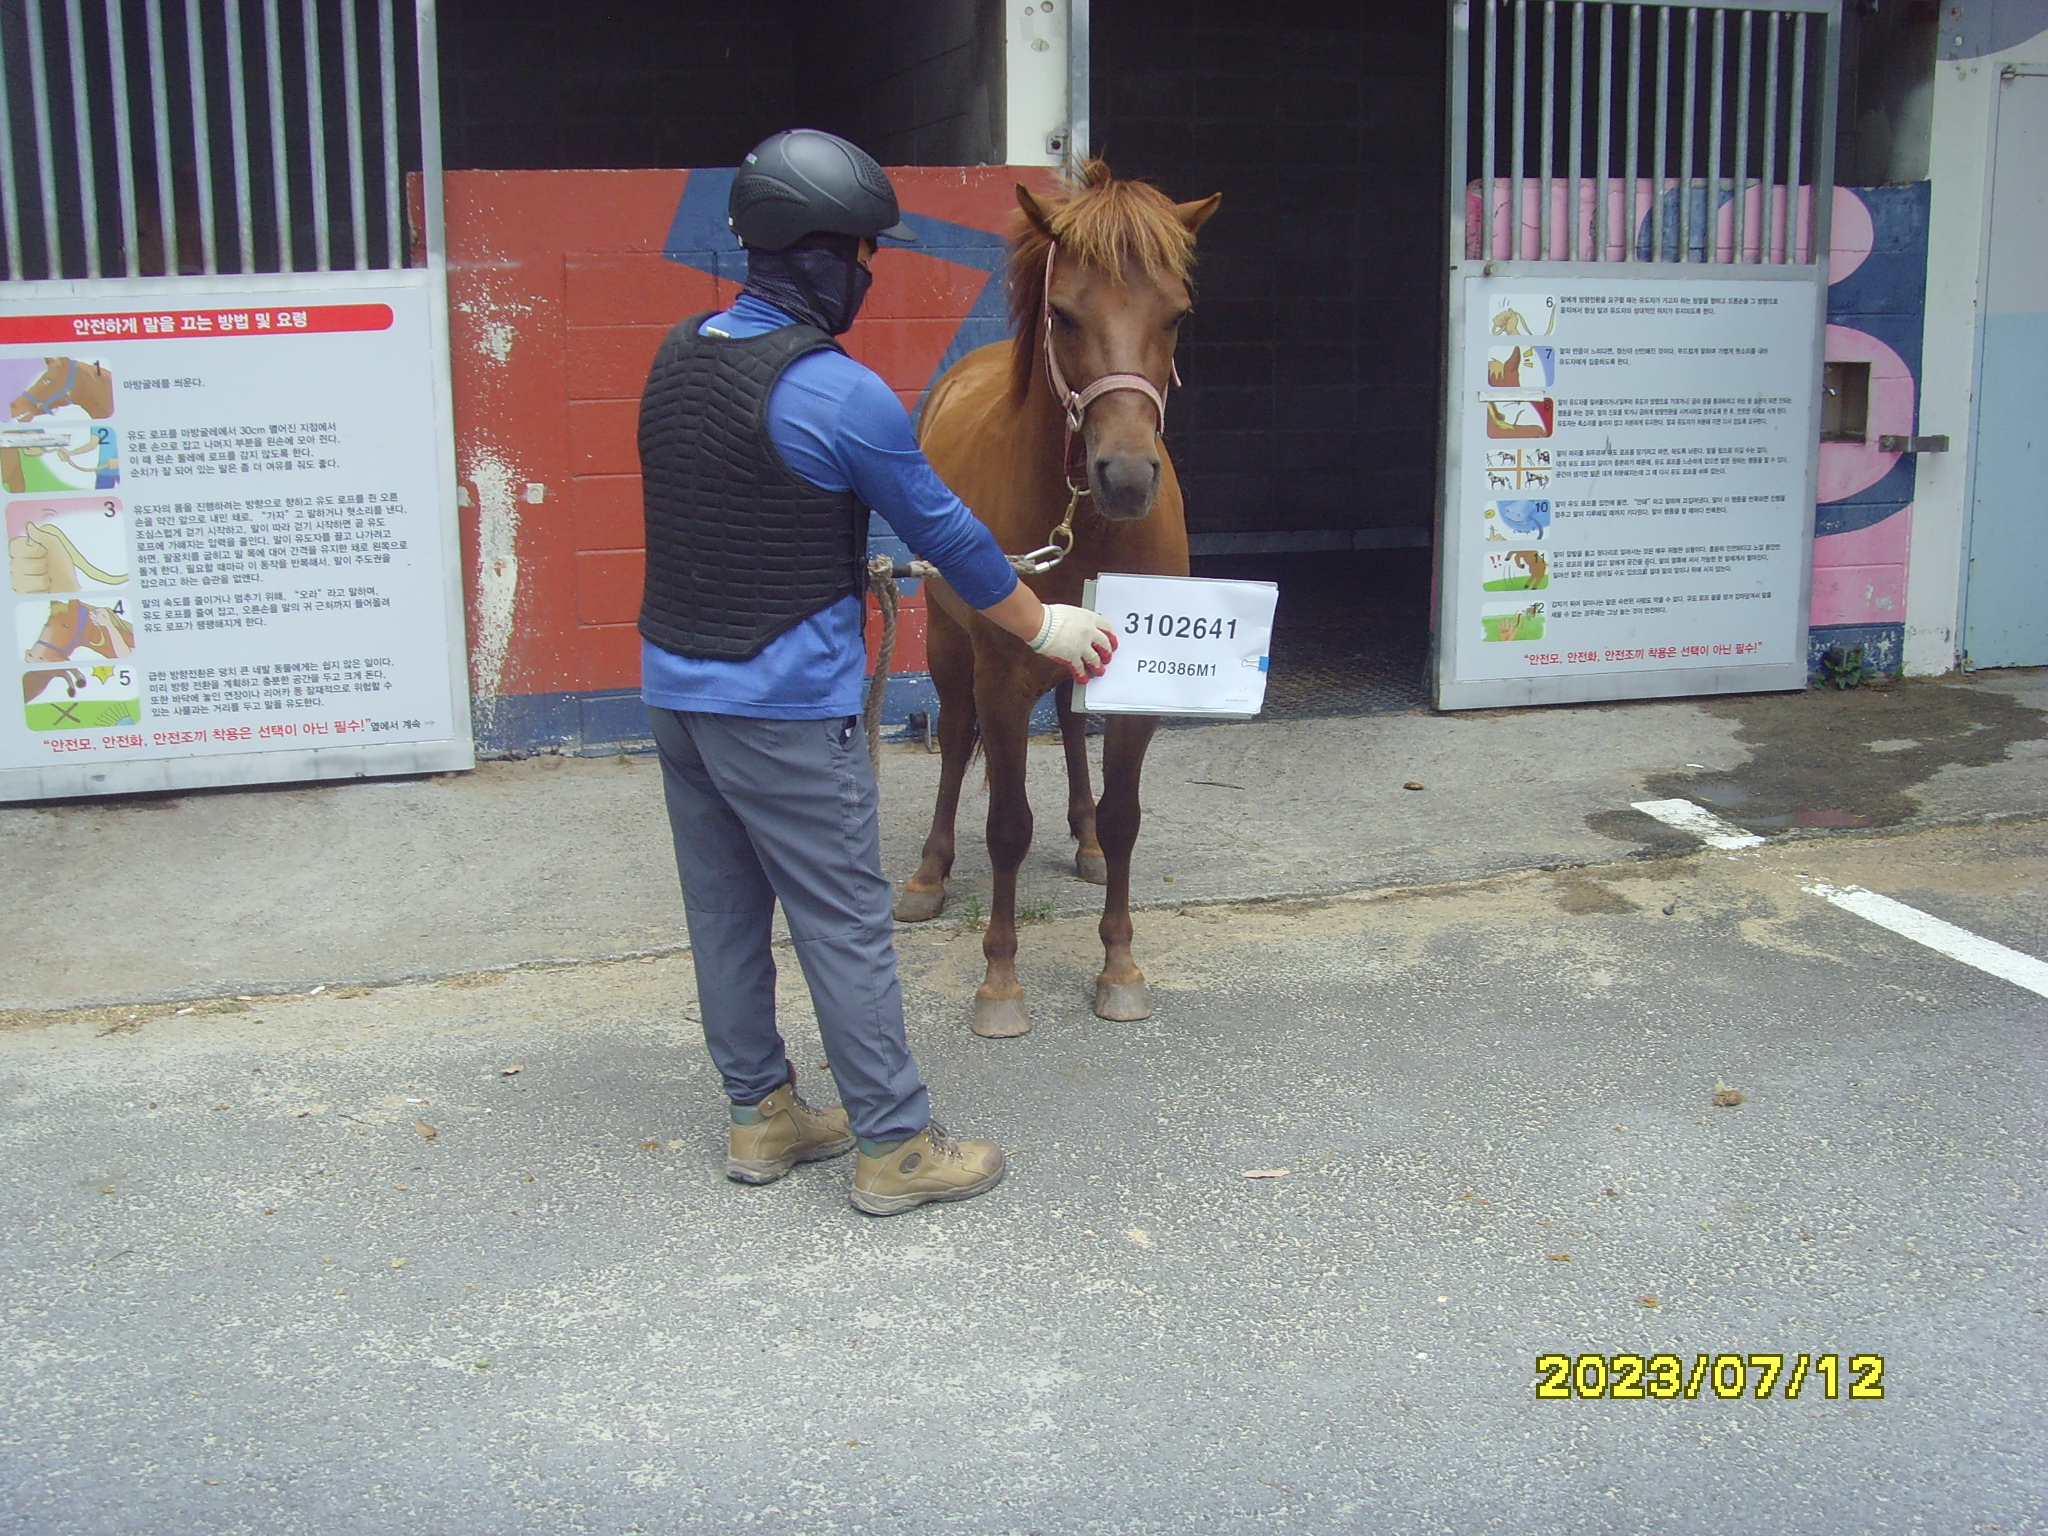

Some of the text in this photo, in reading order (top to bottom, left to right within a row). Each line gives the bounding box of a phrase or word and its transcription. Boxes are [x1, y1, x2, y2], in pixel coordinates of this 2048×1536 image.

[1546, 296, 1553, 308] 6
[73, 311, 306, 335] 안전하게 말을 끄는 방법 및 요령
[1545, 349, 1552, 359] 7
[123, 378, 169, 390] 마방굴레를
[98, 428, 110, 445] 2
[127, 422, 336, 440] 유도 로프를 마방굴레에서 30cm 지점에서
[150, 435, 315, 451] 손으로 잡고 나머지 부분을 왼손에 모아
[155, 447, 312, 464] 왼손 로프를 않도록 한다.
[130, 460, 314, 477] 순치가 되어 있는 말은 여유를 줘도
[104, 501, 116, 518] 3
[133, 492, 397, 514] 유도자의 진행하려는 방향으로 유도 로프를 오른
[1535, 502, 1548, 513] 10
[134, 504, 406, 527] 손을 약간 앞으로 내민 말하거나 낸다.
[135, 517, 384, 539] 조심스럽게 걷기 말이 따라 걷기 시작하면 유도
[137, 529, 391, 551] 로프에 가해지는 줄인다. 말이 유도자를 나가려고
[268, 547, 286, 556] 대어
[290, 545, 316, 555] 간격을
[320, 543, 347, 554] 유지한
[372, 540, 407, 551] 왼쪽으로
[160, 565, 181, 575] 한다.
[186, 563, 213, 573] 필요할
[333, 555, 351, 565] 말이
[355, 553, 390, 564] 주도권을
[140, 574, 228, 588] 잡으려고 하는 습관을
[141, 588, 344, 608] 말의 속도를 줄이거나 멈추기 라고
[112, 600, 124, 617] 4
[142, 610, 160, 620] 유도
[164, 609, 191, 619] 로프를
[195, 607, 213, 617] 줄여
[242, 603, 277, 615] 오른손을
[281, 602, 299, 612] 말의
[144, 623, 161, 632] 유도
[166, 621, 192, 631] 로프가
[245, 617, 266, 626] 한다.
[1125, 612, 1237, 640] 3102641
[1567, 651, 1599, 663] 안전화,
[1605, 649, 1643, 660] 안전조끼
[1648, 647, 1676, 658] 착용은
[1681, 645, 1708, 656] 선택이
[1712, 644, 1731, 655] 아닌
[148, 671, 166, 681] 급한
[169, 668, 214, 680] 방향전환은
[252, 665, 270, 674] 네발
[274, 662, 318, 673] 동물에게는
[322, 660, 339, 670] 쉽지
[343, 659, 360, 669] 않은
[364, 657, 393, 667] 일이다.
[1137, 660, 1217, 677] P20386M1
[119, 670, 131, 686] 5
[149, 683, 167, 692] 미리
[170, 682, 188, 692] 방향
[192, 680, 219, 690] 전환을
[262, 675, 289, 686] 충분한
[292, 673, 319, 684] 공간을
[323, 672, 340, 681] 두고
[344, 671, 361, 680] 크게
[150, 695, 168, 705] 또한
[224, 689, 259, 700] 연장이나
[263, 688, 290, 697] 리어카
[151, 697, 323, 717] 있는 사물과는 거리를 두고 말을 유도한다.
[371, 719, 421, 732] 옆에서 계속
[102, 734, 147, 748] 안전화,
[153, 730, 206, 745] 안전조끼
[213, 726, 251, 741] 착용은
[259, 724, 296, 738] 선택이
[303, 722, 327, 735] 아닌
